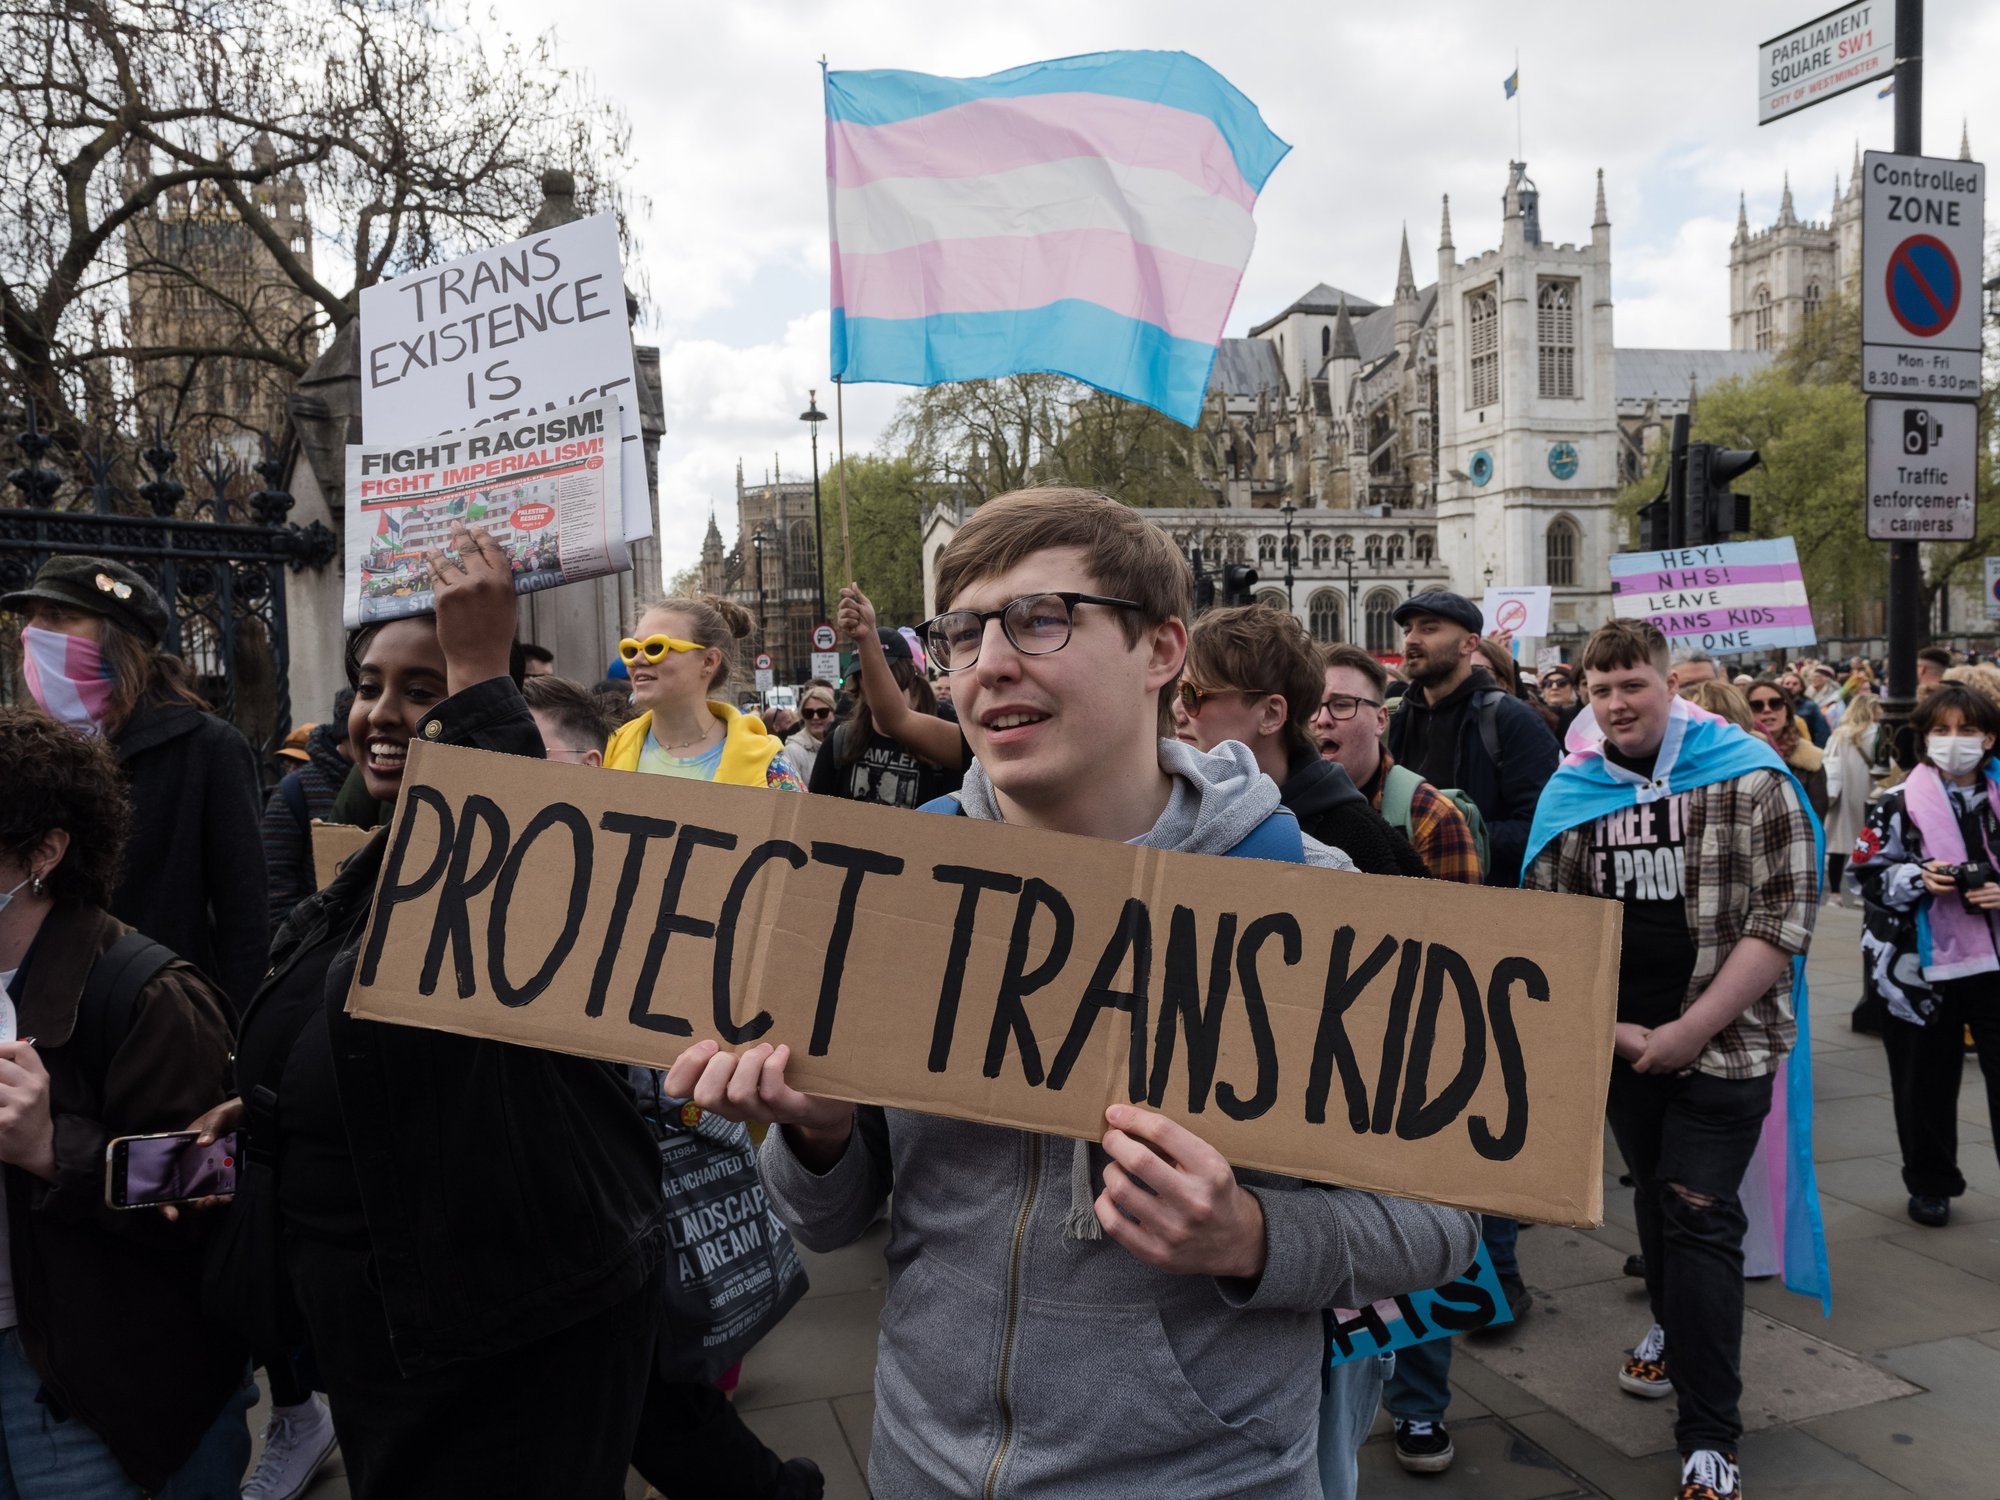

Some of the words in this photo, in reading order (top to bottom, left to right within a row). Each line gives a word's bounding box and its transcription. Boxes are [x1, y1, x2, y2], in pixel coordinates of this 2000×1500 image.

[1771, 6, 1872, 66] PARLIAMENT
[1771, 47, 1832, 88] SQUARE
[1838, 29, 1873, 59] SW1
[1771, 94, 1791, 109] CITY
[1793, 87, 1805, 100] OF
[1808, 57, 1879, 94] WESTMINSTER
[1873, 163, 1977, 194] Controlled
[1888, 195, 1960, 226] ZONE
[400, 238, 561, 323] TRANS
[370, 274, 611, 389] EXISTENCE
[1897, 354, 1924, 368] Mon
[1933, 356, 1950, 369] Fri
[467, 360, 522, 409] IS
[1868, 371, 1898, 386] 8.30
[1901, 375, 1919, 386] am
[1928, 373, 1957, 388] 6.30
[1959, 378, 1977, 391] pm
[361, 441, 462, 476] FIGHT
[468, 408, 605, 461] RACISM!
[360, 472, 435, 498] FIGHT
[442, 436, 605, 487] IMPERIALISM!
[1898, 467, 1948, 485] Traffic
[517, 507, 549, 516] PALESTINE
[519, 514, 545, 522] RESISTS
[1890, 517, 1954, 533] cameras
[1661, 546, 1724, 569] HEY!
[1658, 567, 1731, 590] NHS!
[1649, 591, 1721, 611] LEAVE
[1648, 613, 1711, 633] RANS
[1728, 608, 1775, 626] KIDS
[1595, 803, 1658, 847] FREE
[360, 784, 905, 1056] PROTECT
[928, 864, 1301, 1121] TRANS
[1305, 924, 1550, 1162] KIDS
[662, 1144, 698, 1164] ST.1984
[666, 1184, 771, 1250] LANDSCAP
[709, 1283, 745, 1310] SHEFFIELD
